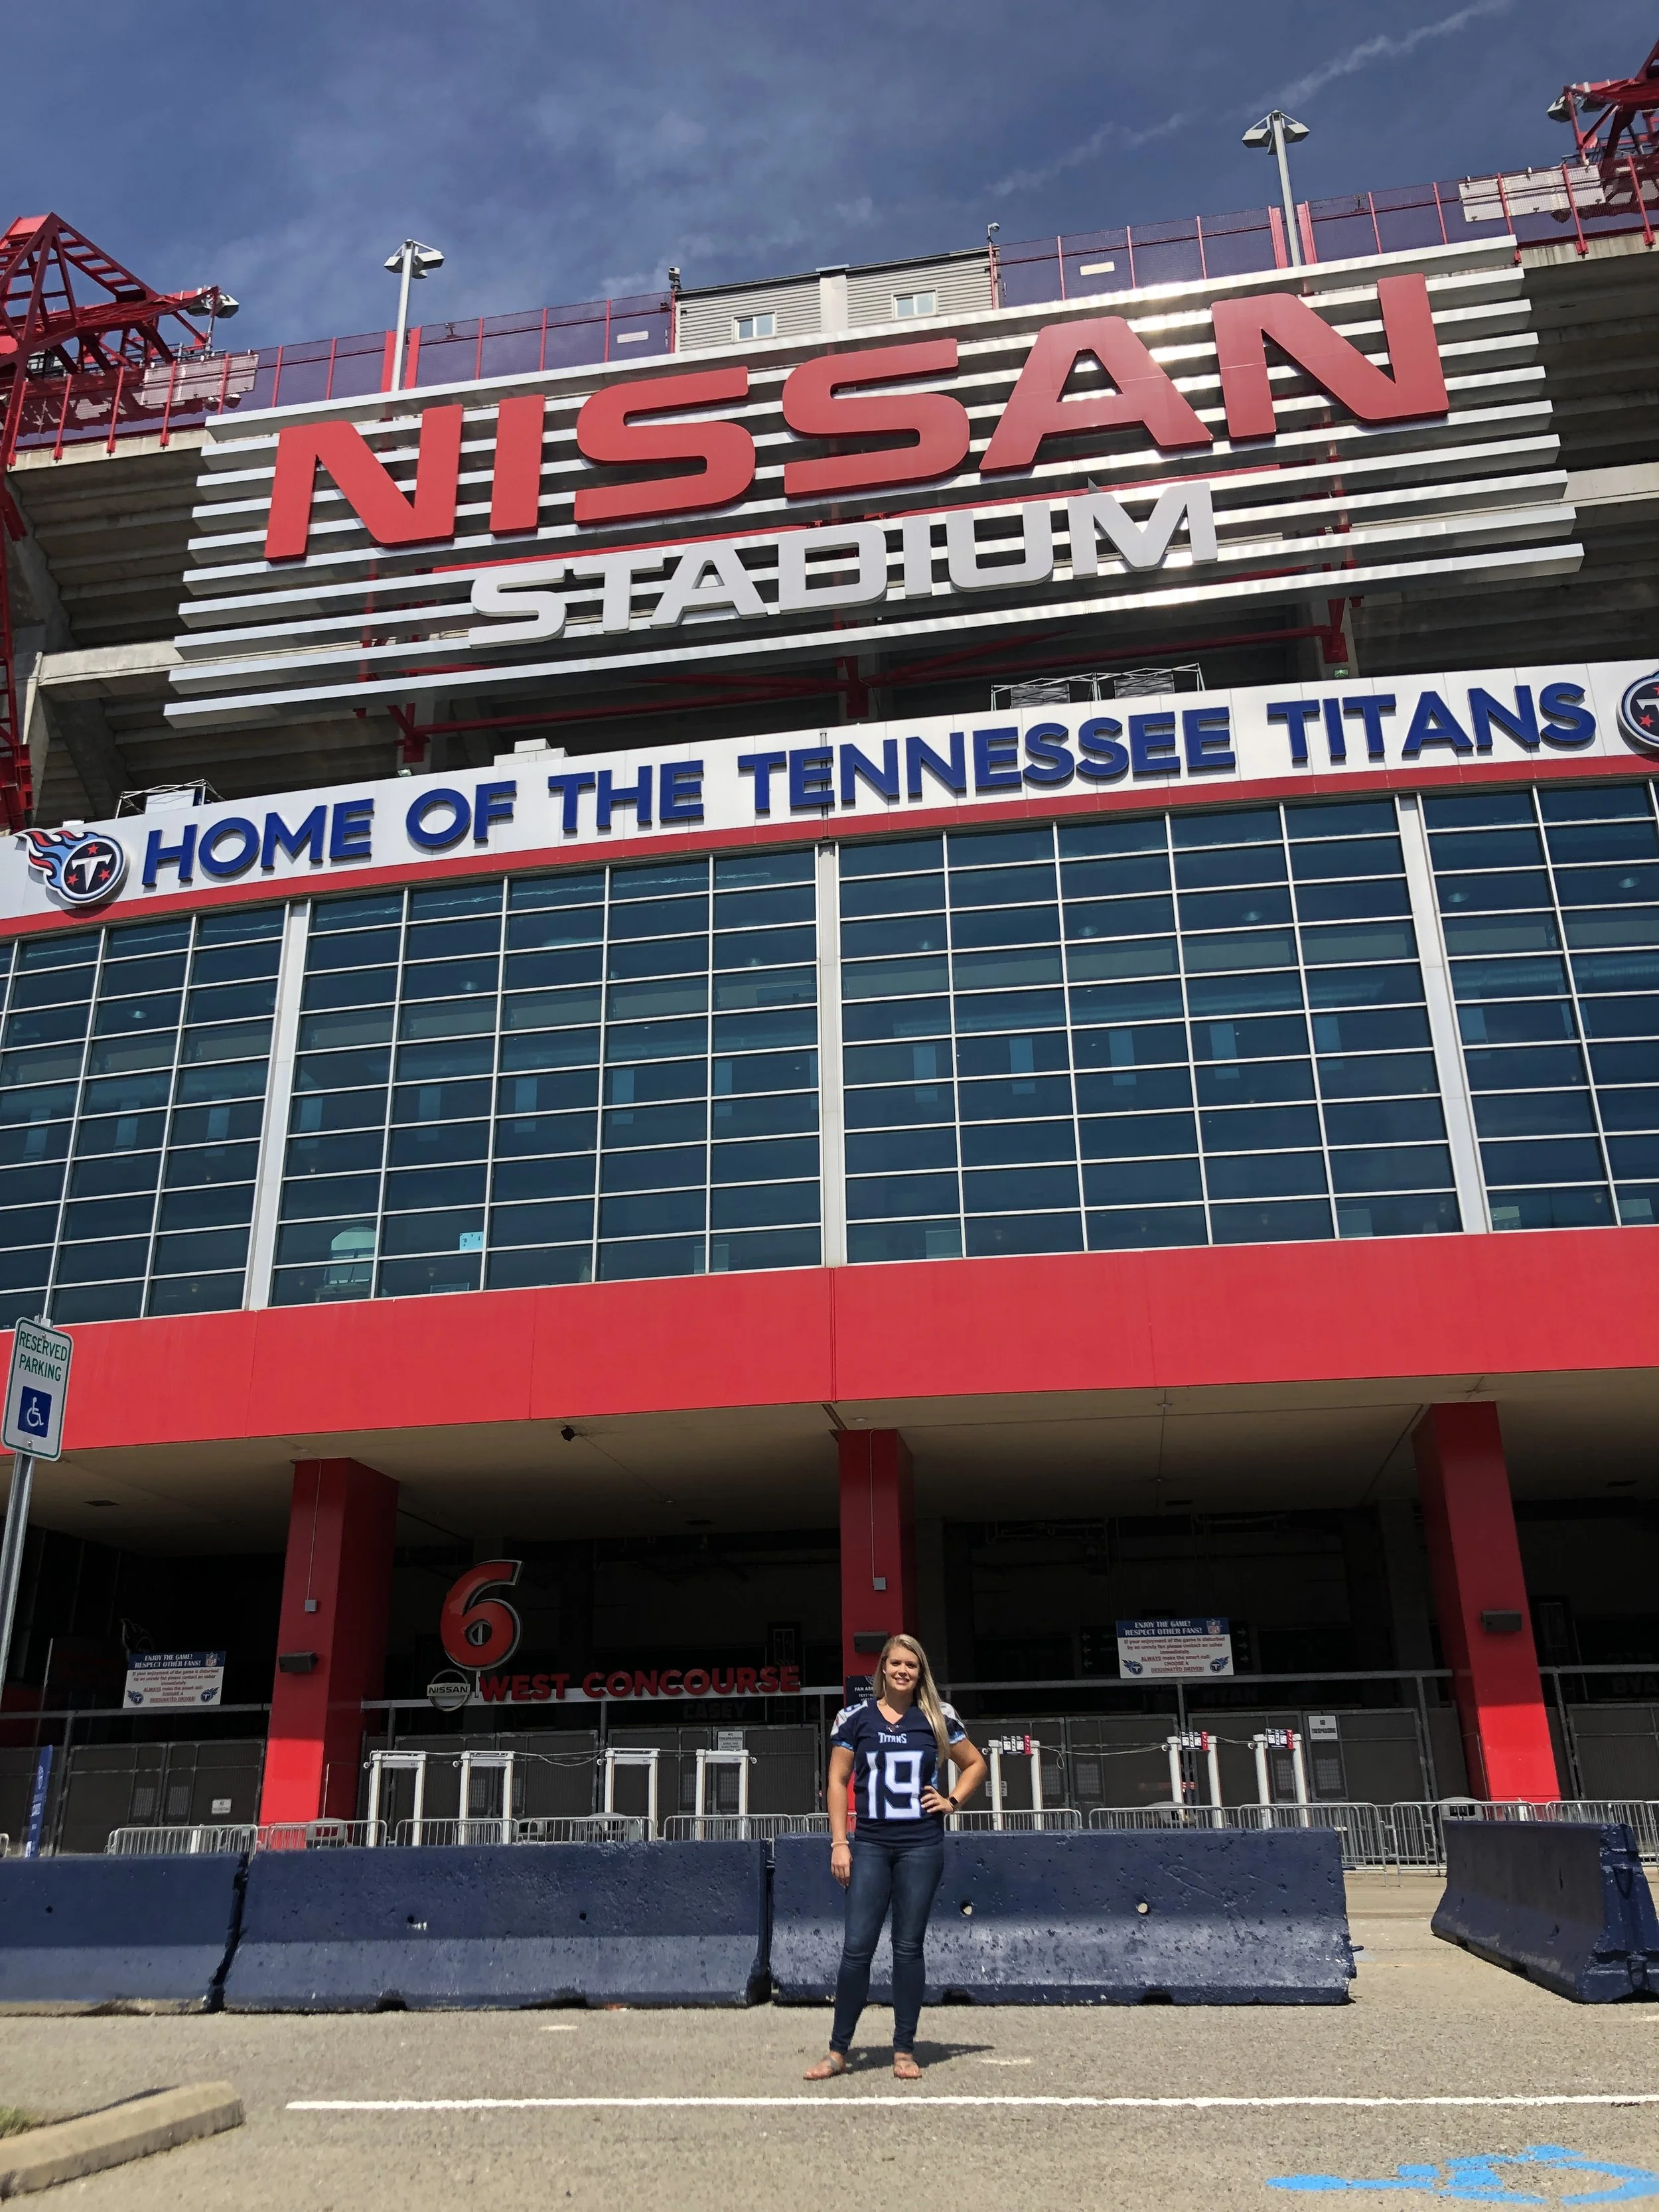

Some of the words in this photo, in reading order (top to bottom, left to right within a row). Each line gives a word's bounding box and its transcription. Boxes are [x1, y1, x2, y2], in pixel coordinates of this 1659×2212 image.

[263, 272, 1450, 562] NISSAN
[469, 481, 1218, 649] STADIUM
[142, 798, 376, 887] HOME
[405, 780, 516, 848] OF
[548, 758, 705, 832] THE
[738, 707, 1236, 812] TENNESSEE
[1267, 682, 1596, 759] TITANS
[19, 1331, 68, 1362] RESERVED
[19, 1353, 62, 1382] PARKING
[441, 1559, 525, 1671] 6
[478, 1672, 570, 1702] WEST
[582, 1665, 801, 1699] CONCOURSE
[683, 1702, 747, 1720] CASEY
[877, 1732, 908, 1744] TITANS
[865, 1749, 924, 1820] 19
